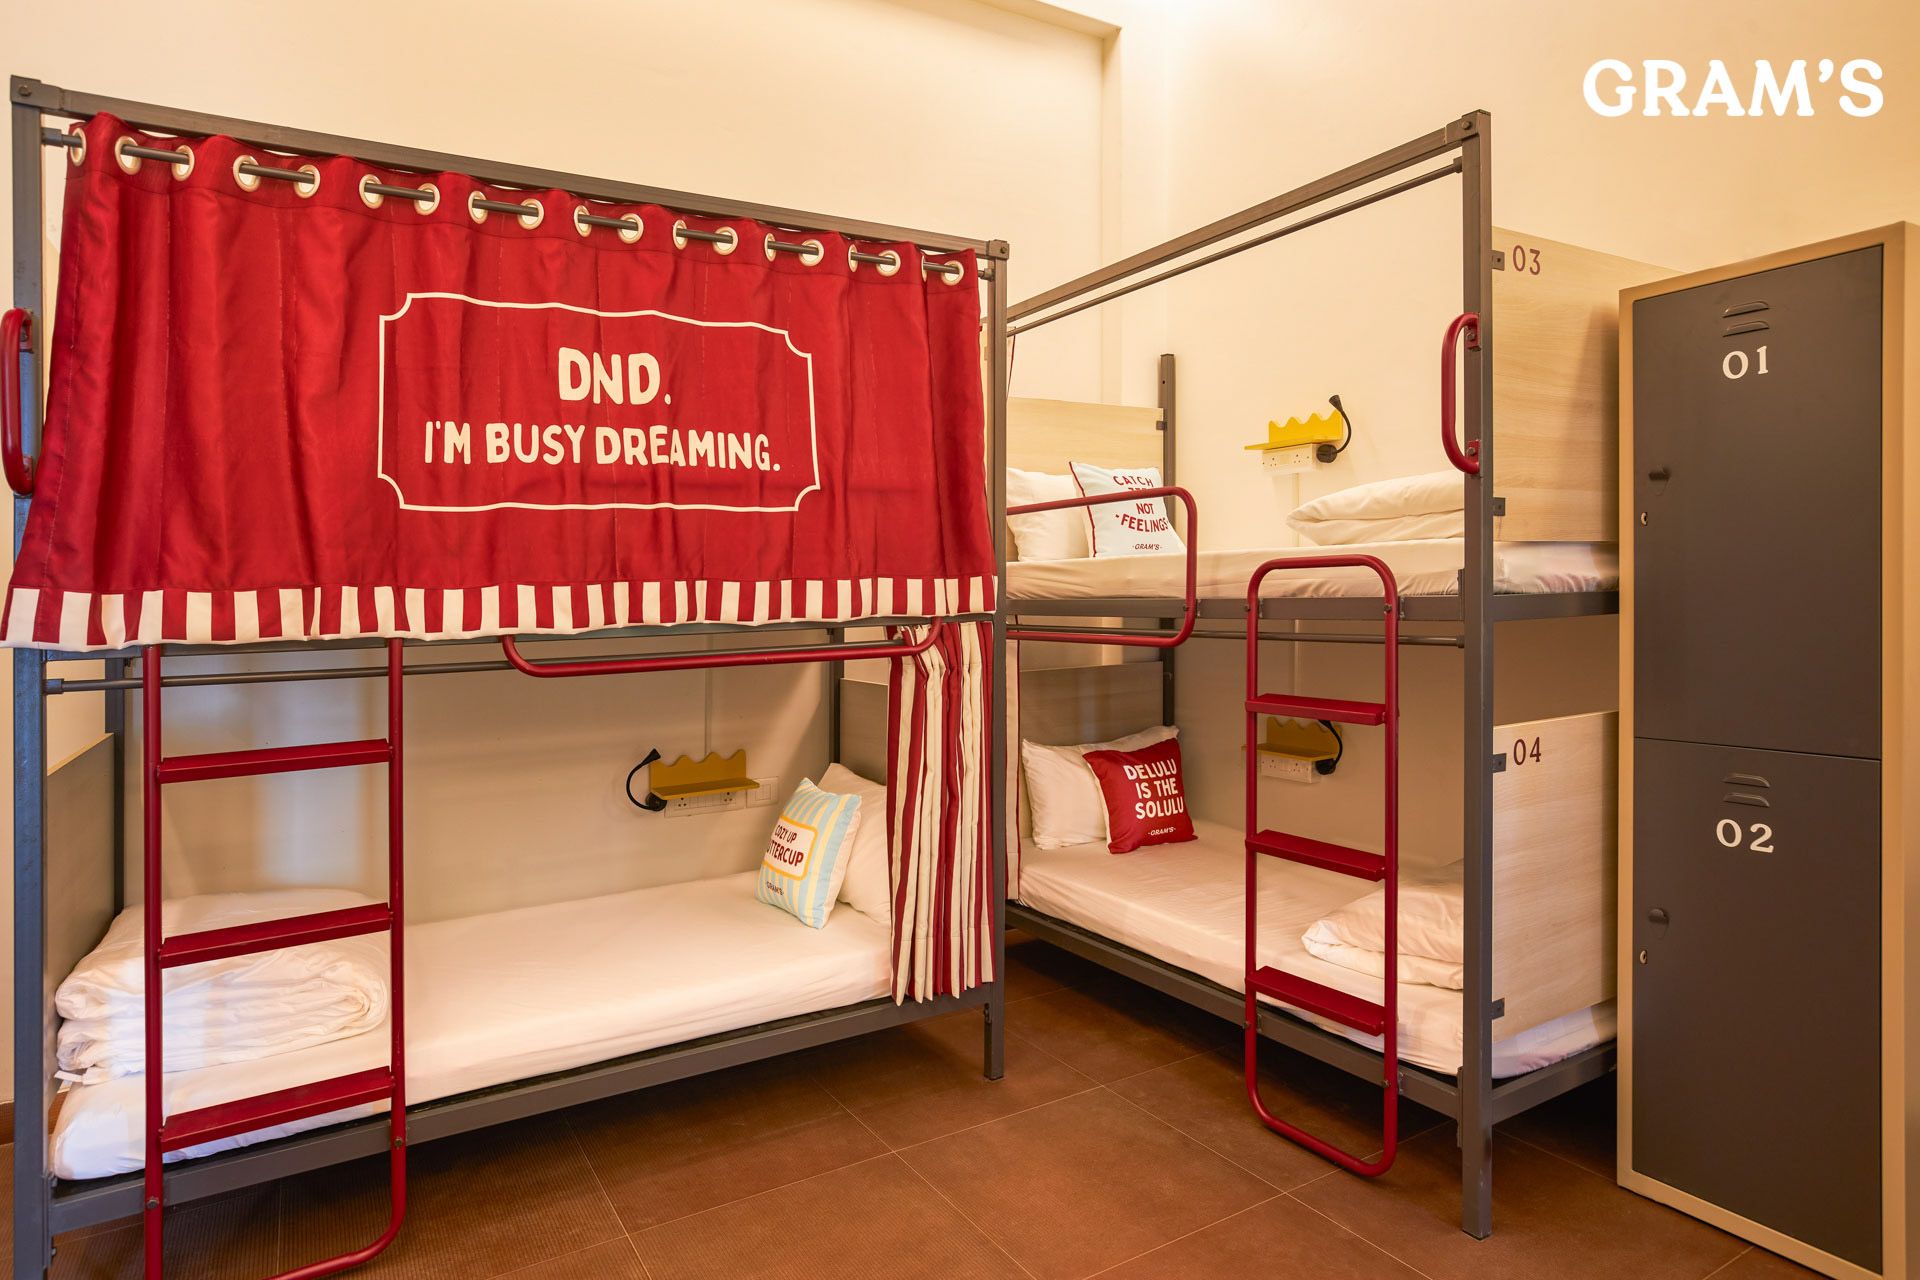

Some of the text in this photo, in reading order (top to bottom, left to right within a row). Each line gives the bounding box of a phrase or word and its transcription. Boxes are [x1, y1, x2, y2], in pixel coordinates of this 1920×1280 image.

[1513, 245, 1541, 275] 03
[1722, 345, 1769, 379] 01
[558, 347, 671, 405] DND.
[424, 421, 781, 471] I'M BUSY DREAMING.
[1113, 475, 1154, 487] CATCH
[1136, 503, 1155, 514] NOT
[1513, 736, 1541, 765] 04
[1123, 758, 1177, 780] DELULU
[1135, 777, 1178, 799] IS THE
[1135, 796, 1184, 820] SOLULU
[786, 831, 798, 844] UP
[1716, 818, 1775, 853] 02
